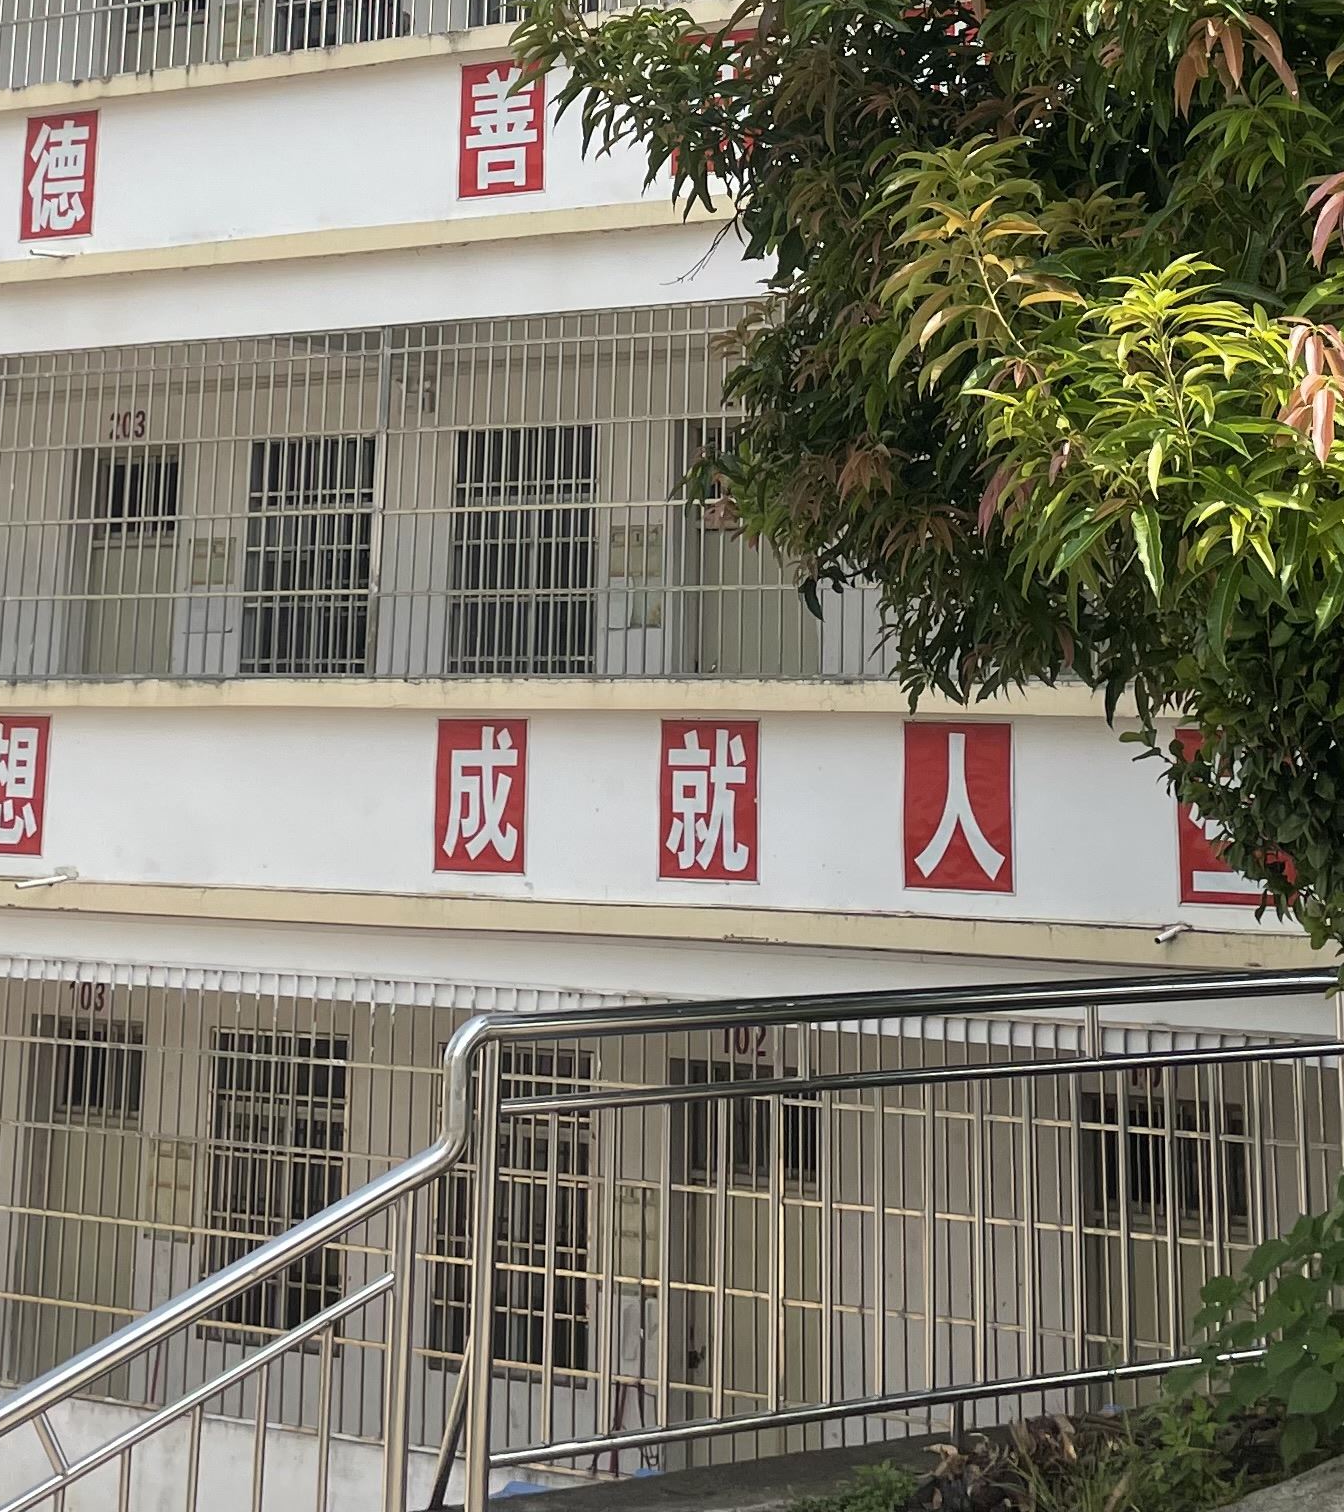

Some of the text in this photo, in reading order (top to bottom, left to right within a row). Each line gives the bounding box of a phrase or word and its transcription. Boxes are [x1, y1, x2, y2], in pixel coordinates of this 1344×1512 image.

[465, 66, 538, 190] 善
[109, 410, 145, 440] 203
[443, 730, 1274, 893] 成就人
[69, 980, 105, 1012] 103
[722, 1027, 767, 1057] 102
